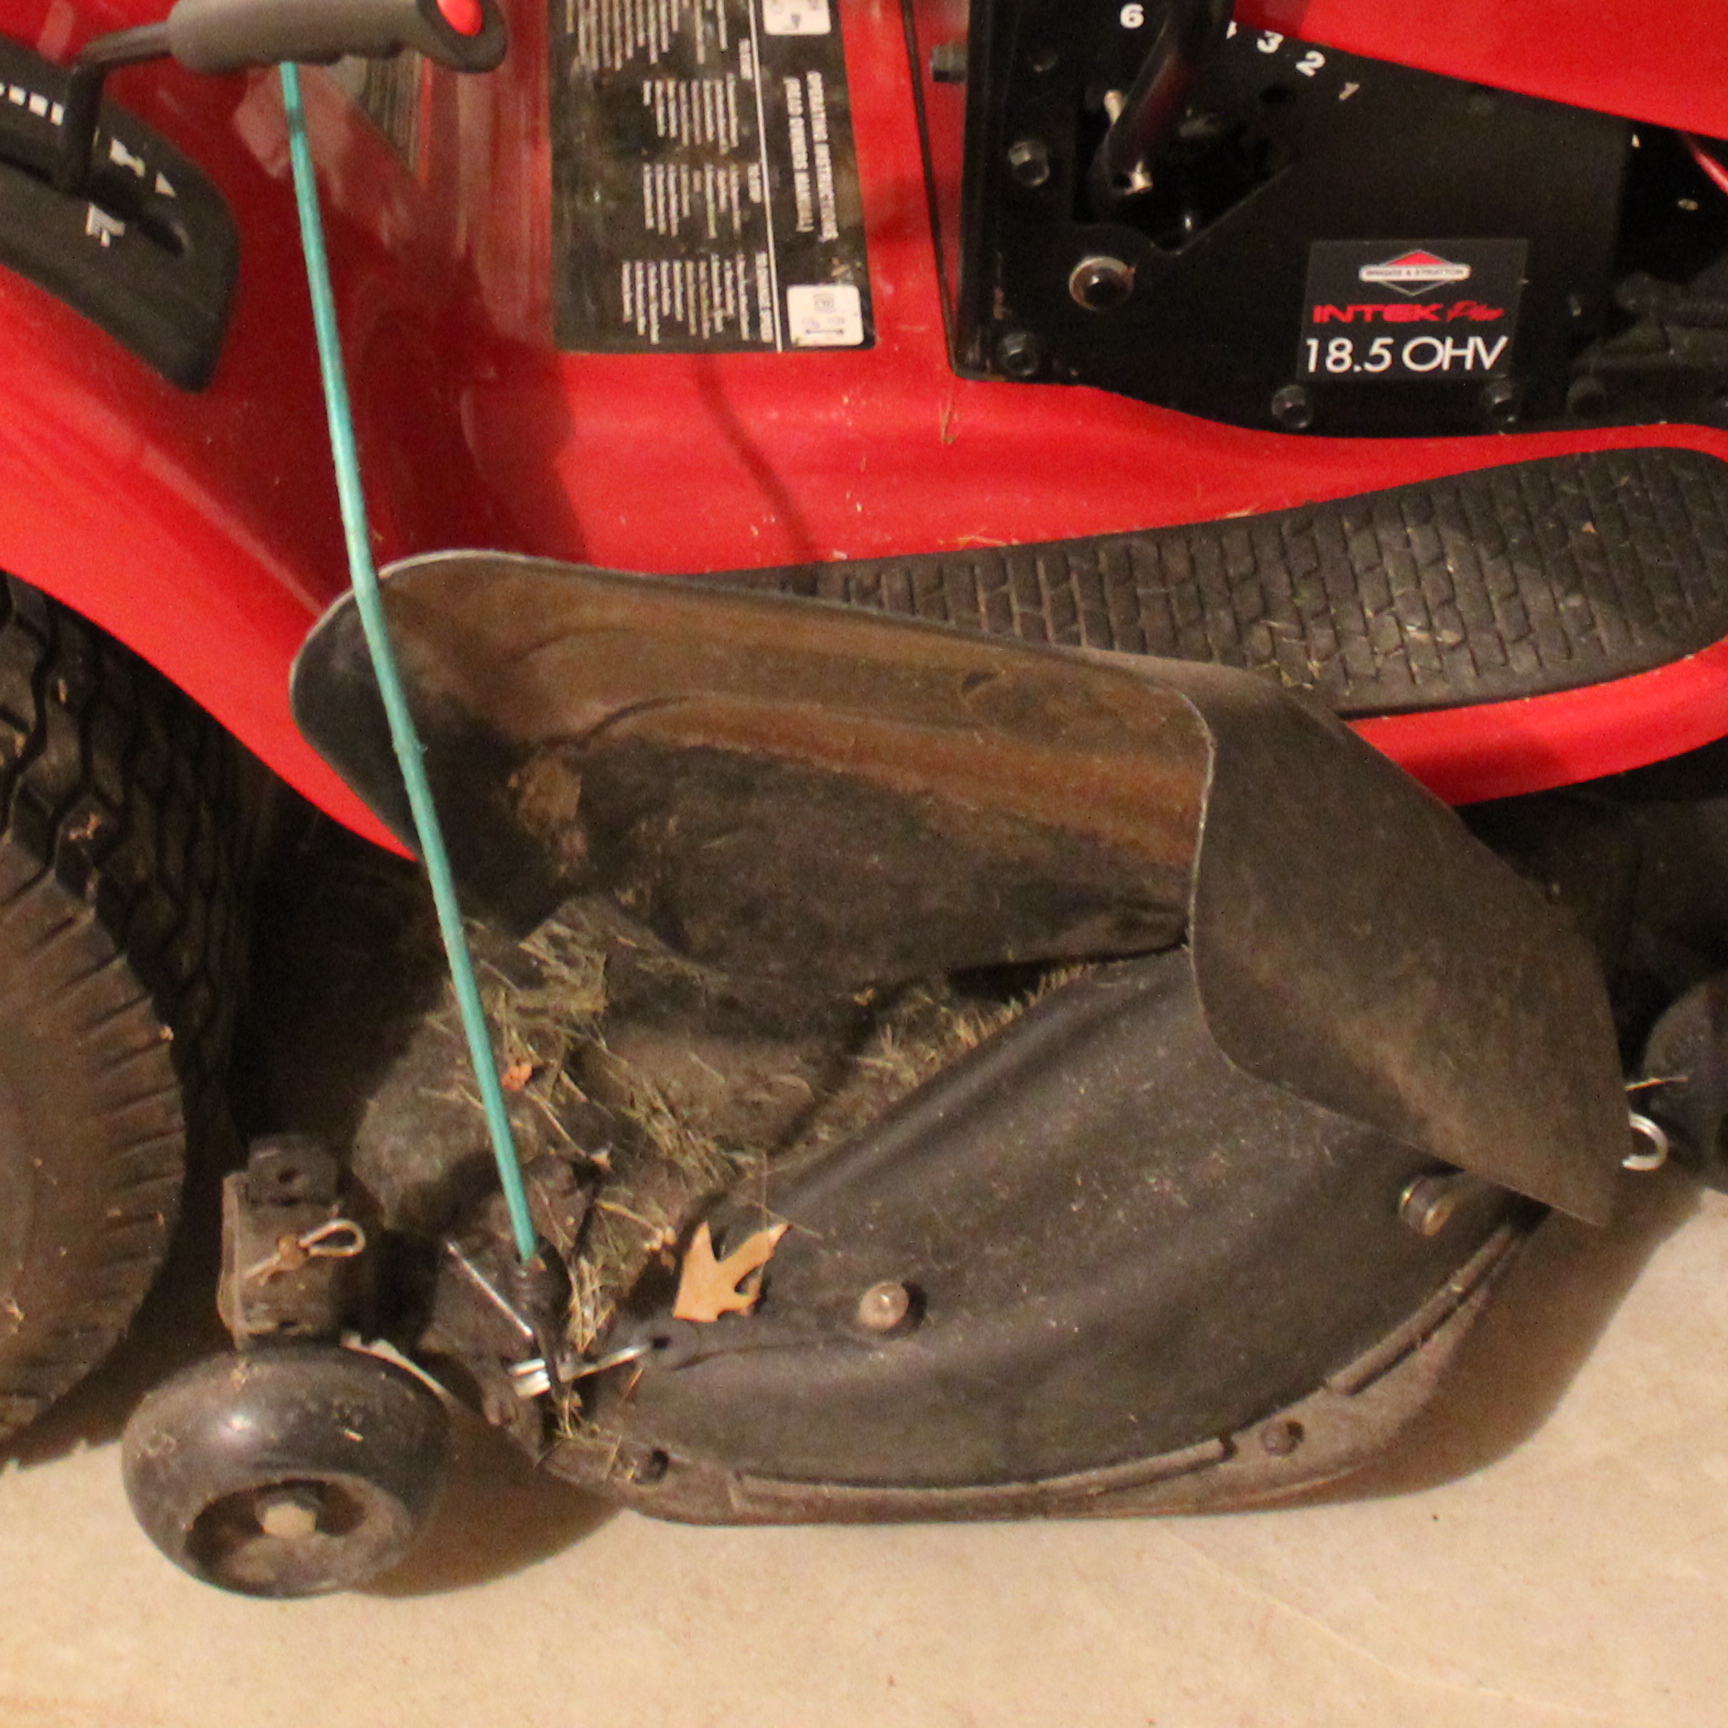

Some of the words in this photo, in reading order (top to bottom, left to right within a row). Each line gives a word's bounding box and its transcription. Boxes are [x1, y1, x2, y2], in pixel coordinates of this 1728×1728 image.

[1119, 3, 1145, 29] 6
[1257, 30, 1285, 54] 3
[1295, 51, 1326, 77] 2
[1312, 303, 1444, 324] INTEK
[1306, 336, 1395, 373] 18.5
[1401, 335, 1509, 373] OHV
